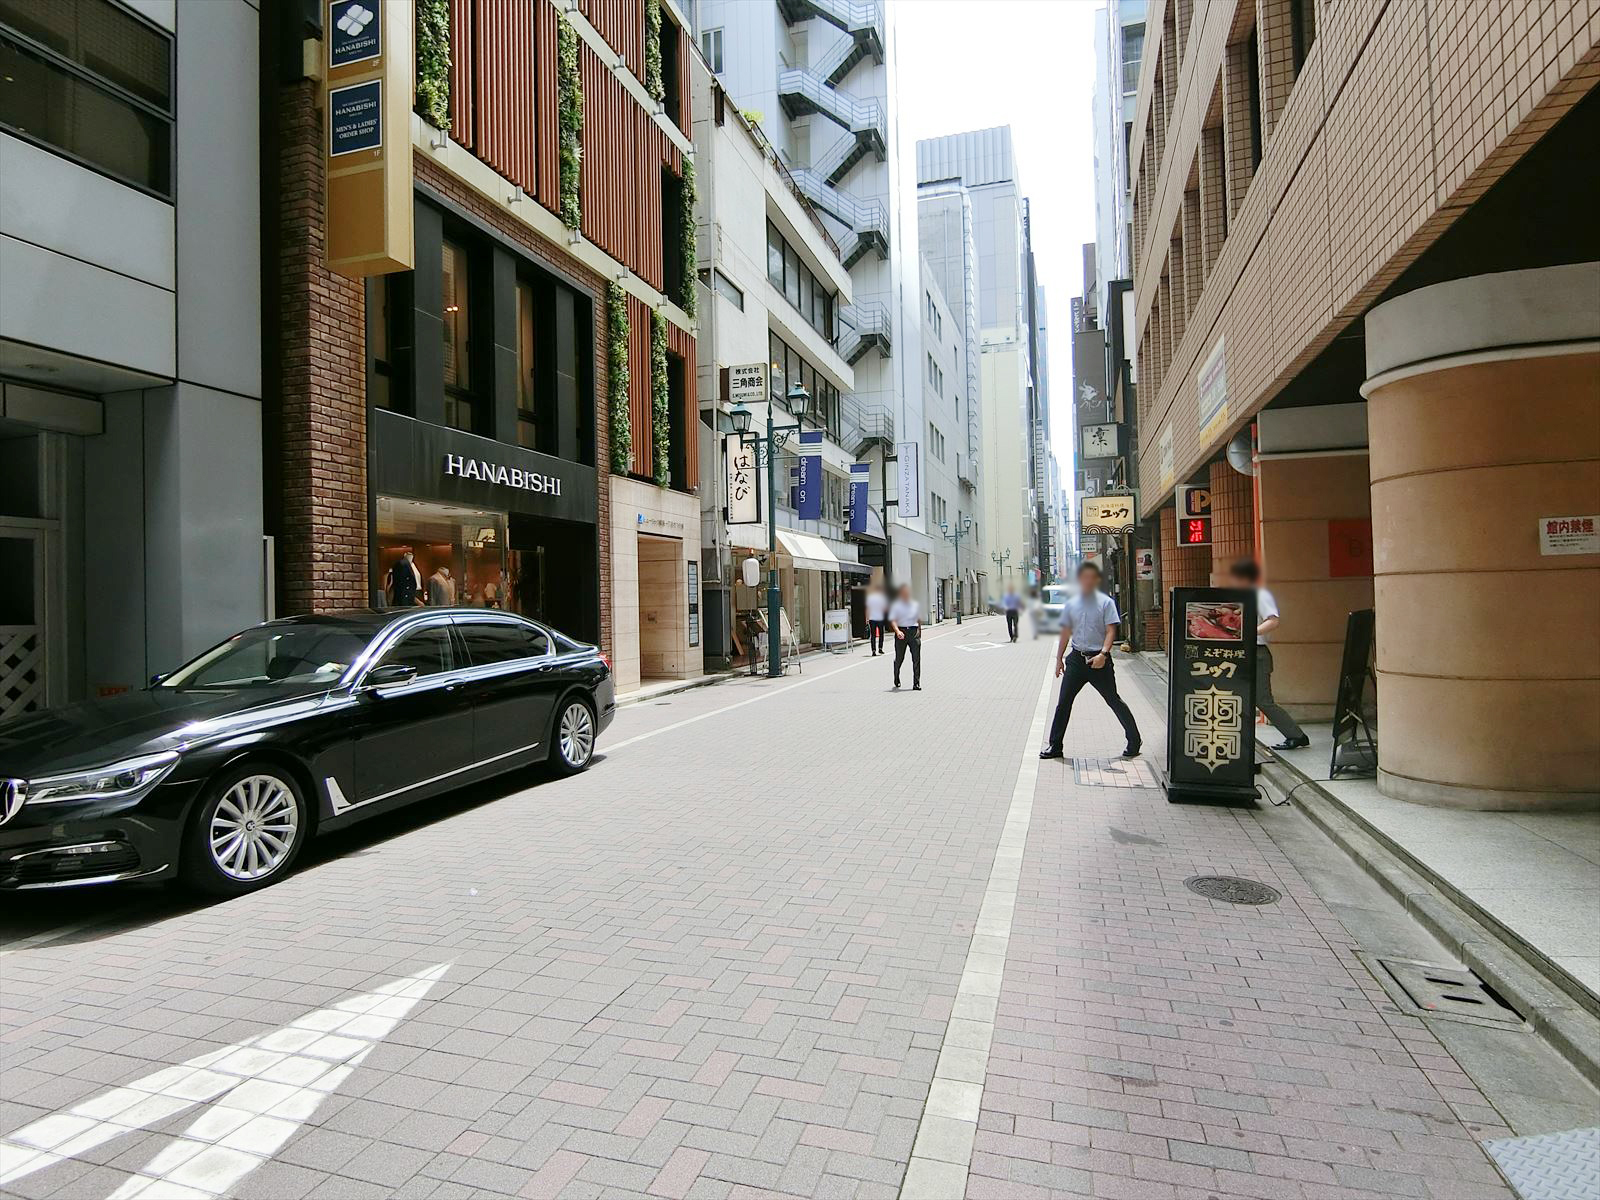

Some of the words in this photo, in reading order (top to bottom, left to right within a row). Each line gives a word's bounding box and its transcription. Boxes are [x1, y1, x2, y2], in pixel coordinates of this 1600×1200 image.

[335, 38, 376, 54] HANABISHI
[335, 101, 377, 116] HANABISHI
[336, 124, 352, 133] MEN'S
[339, 130, 358, 139] ORDER
[358, 126, 374, 135] SHOP
[373, 149, 381, 157] 1F
[735, 366, 760, 375] 株式会社
[732, 376, 763, 389] 三角商会
[445, 453, 561, 496] HANABISHI
[800, 456, 808, 485] dream
[734, 455, 750, 501] はなび
[800, 490, 806, 503] on
[850, 483, 858, 506] dream
[850, 509, 855, 520] on
[1100, 508, 1129, 519] ユック
[1546, 518, 1594, 535] 館内禁煙
[1203, 647, 1246, 659] えぞ料理
[1190, 661, 1237, 679] ユック
